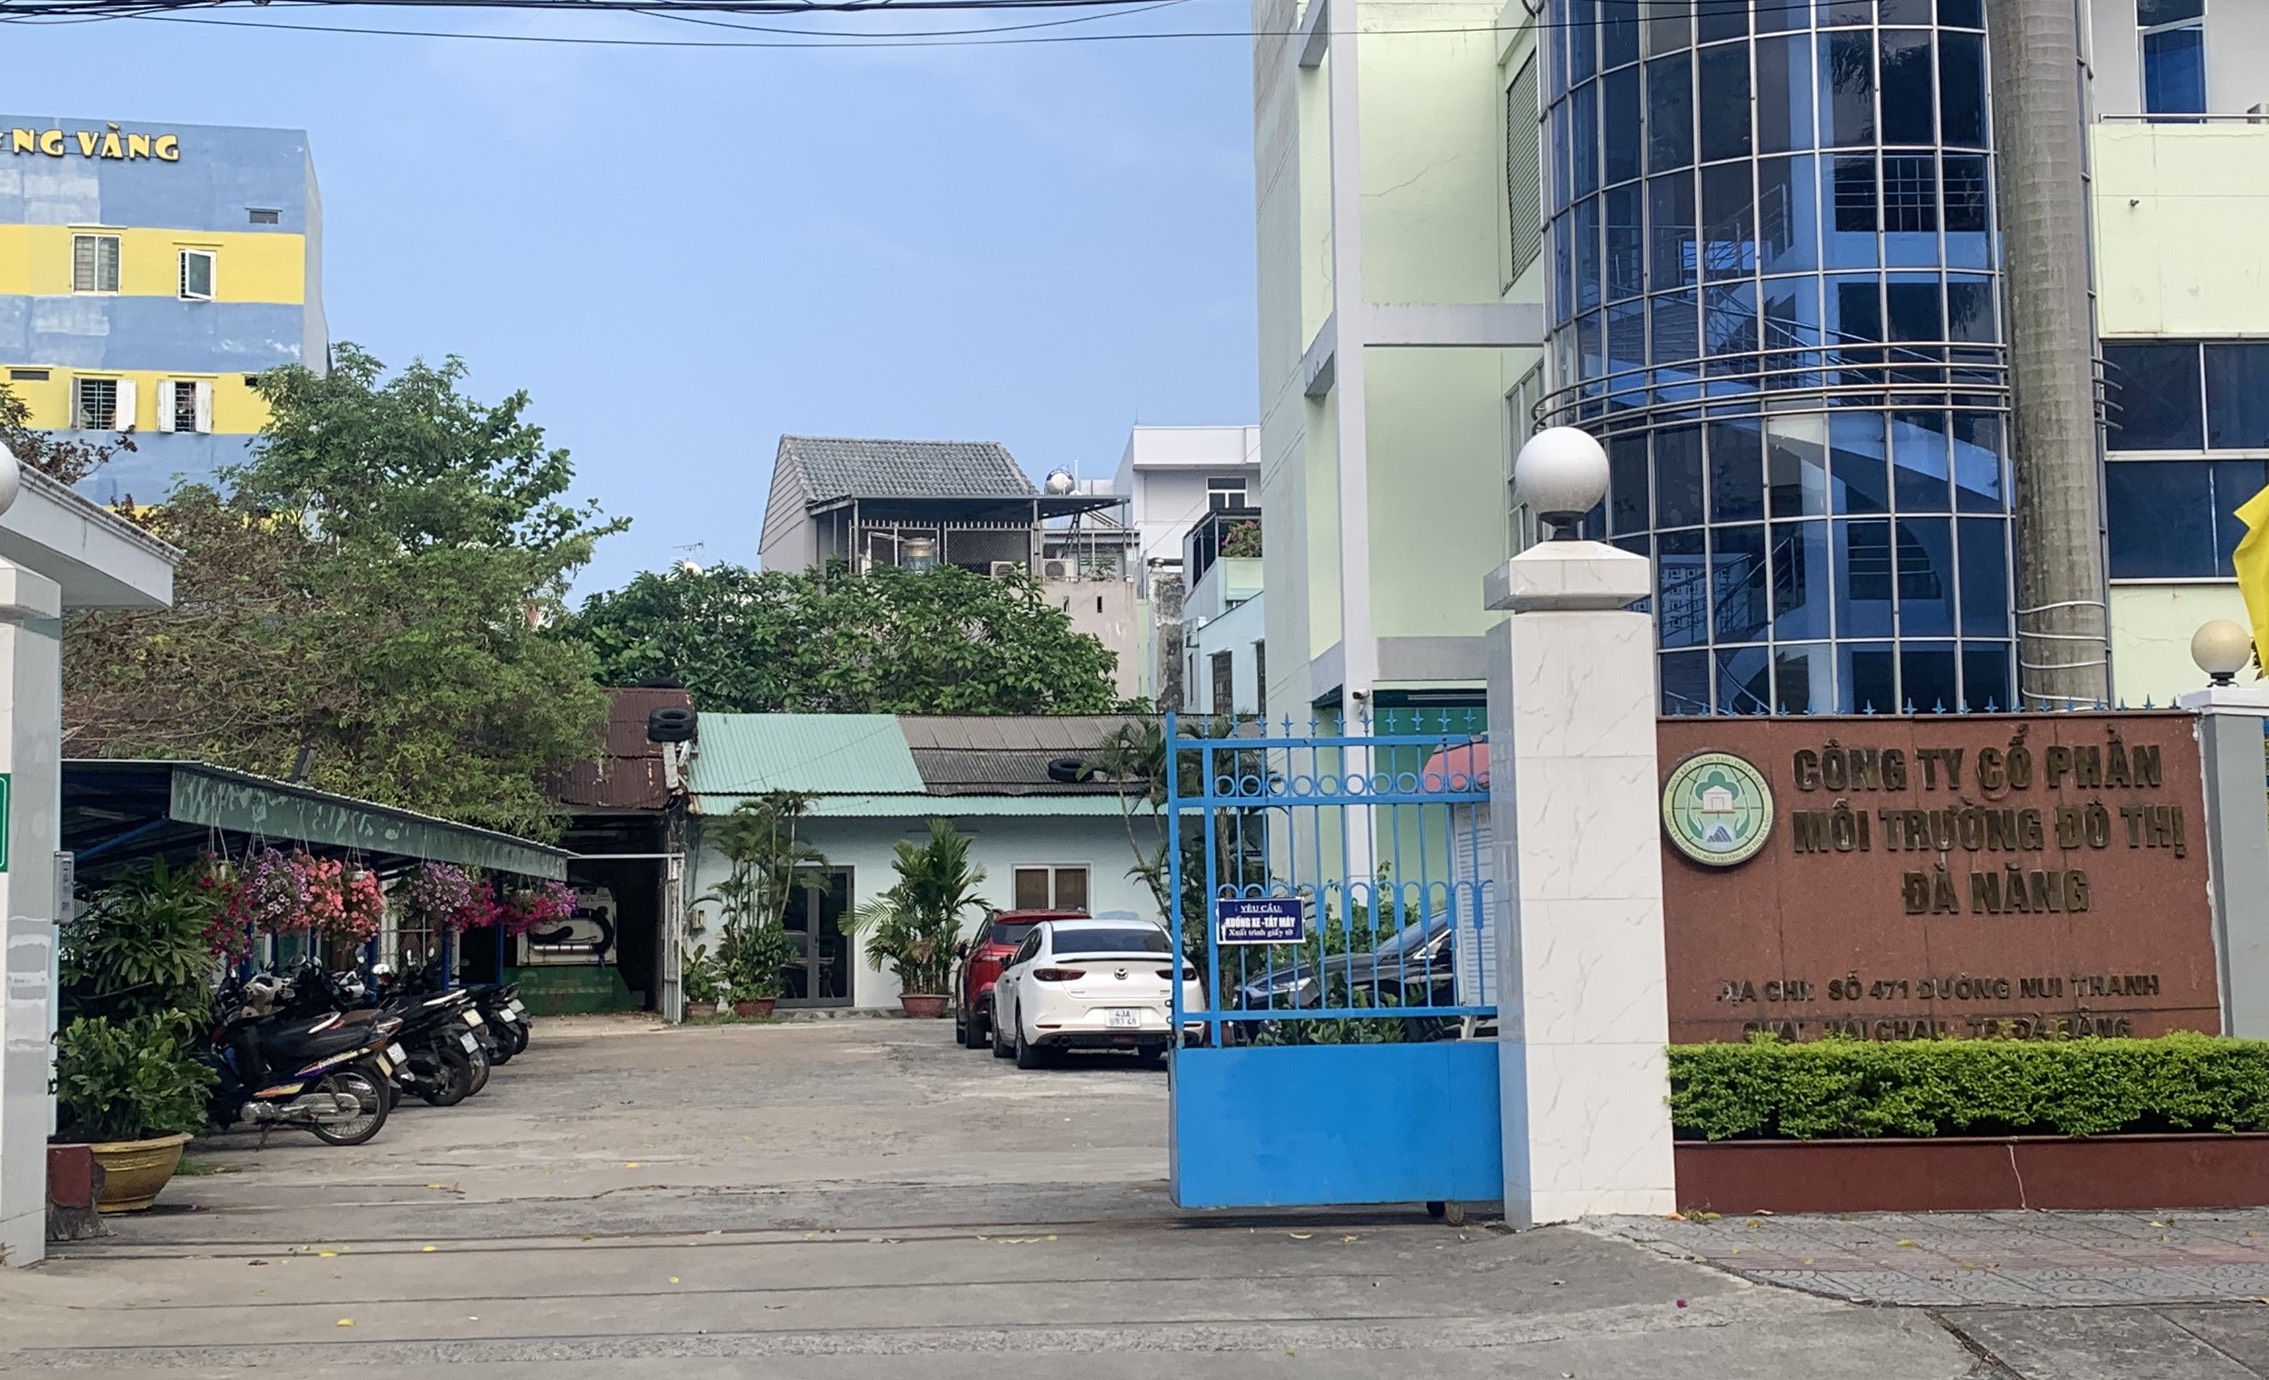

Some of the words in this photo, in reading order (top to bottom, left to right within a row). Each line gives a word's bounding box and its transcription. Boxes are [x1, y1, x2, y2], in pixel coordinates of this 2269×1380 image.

[0, 128, 66, 157] NG
[76, 121, 181, 162] VÀNG
[1792, 738, 1907, 791] CÔNG
[1916, 746, 1965, 789] TY
[1977, 723, 2033, 789] CỔ
[2046, 722, 2163, 789] PHẦN
[1792, 796, 1871, 852] MÔI
[1878, 795, 2045, 852] TRƯỜNG
[2055, 796, 2111, 850] ĐÔ
[2120, 804, 2187, 859] THỊ
[1902, 862, 1960, 915] ĐÀ
[1869, 979, 1909, 1000] 471
